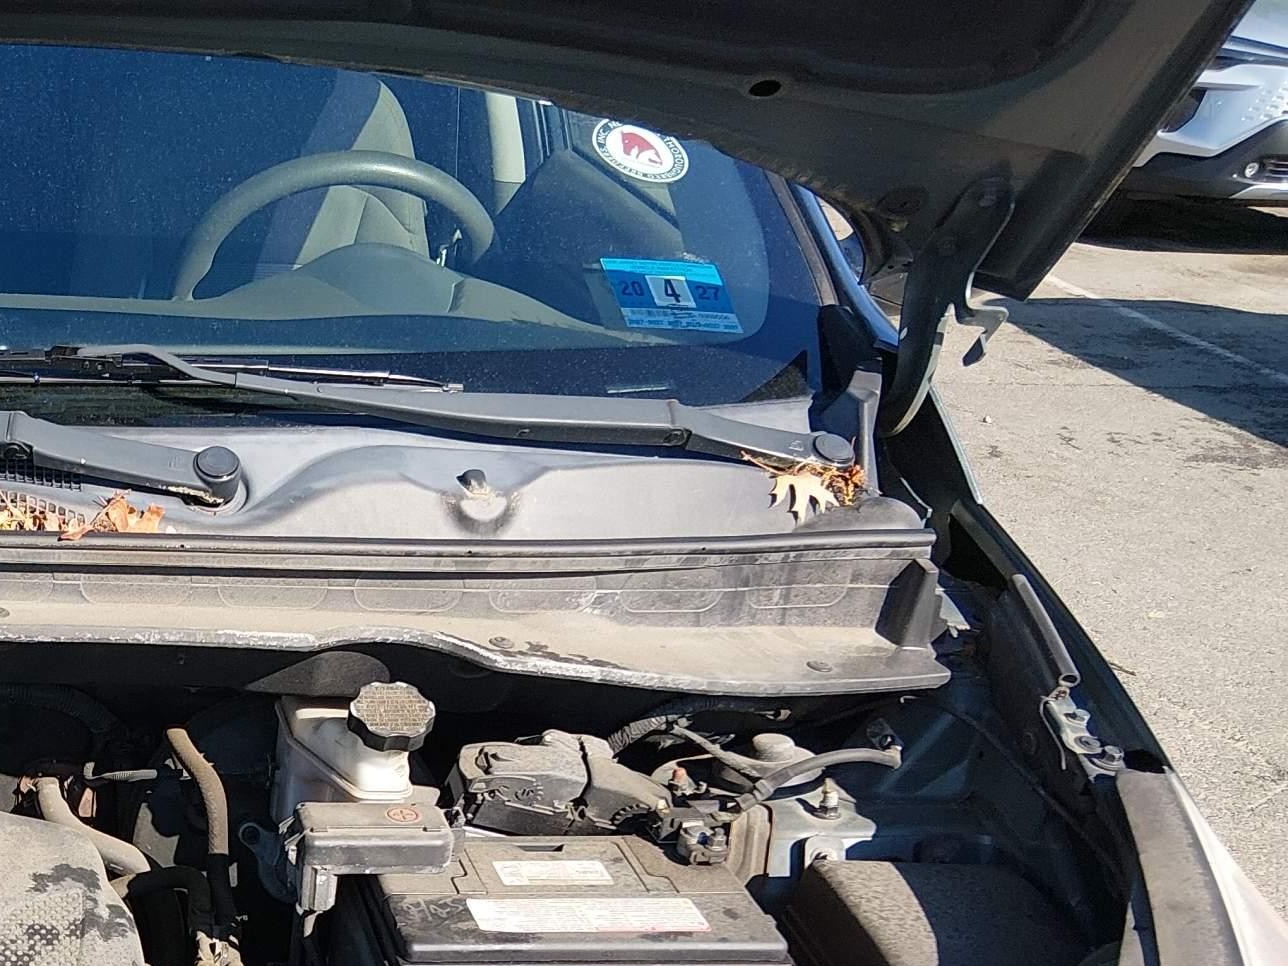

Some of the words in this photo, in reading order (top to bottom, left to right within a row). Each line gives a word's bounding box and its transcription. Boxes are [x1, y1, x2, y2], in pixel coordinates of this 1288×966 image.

[618, 280, 644, 297] 20
[664, 278, 680, 303] 4
[695, 285, 720, 301] 27
